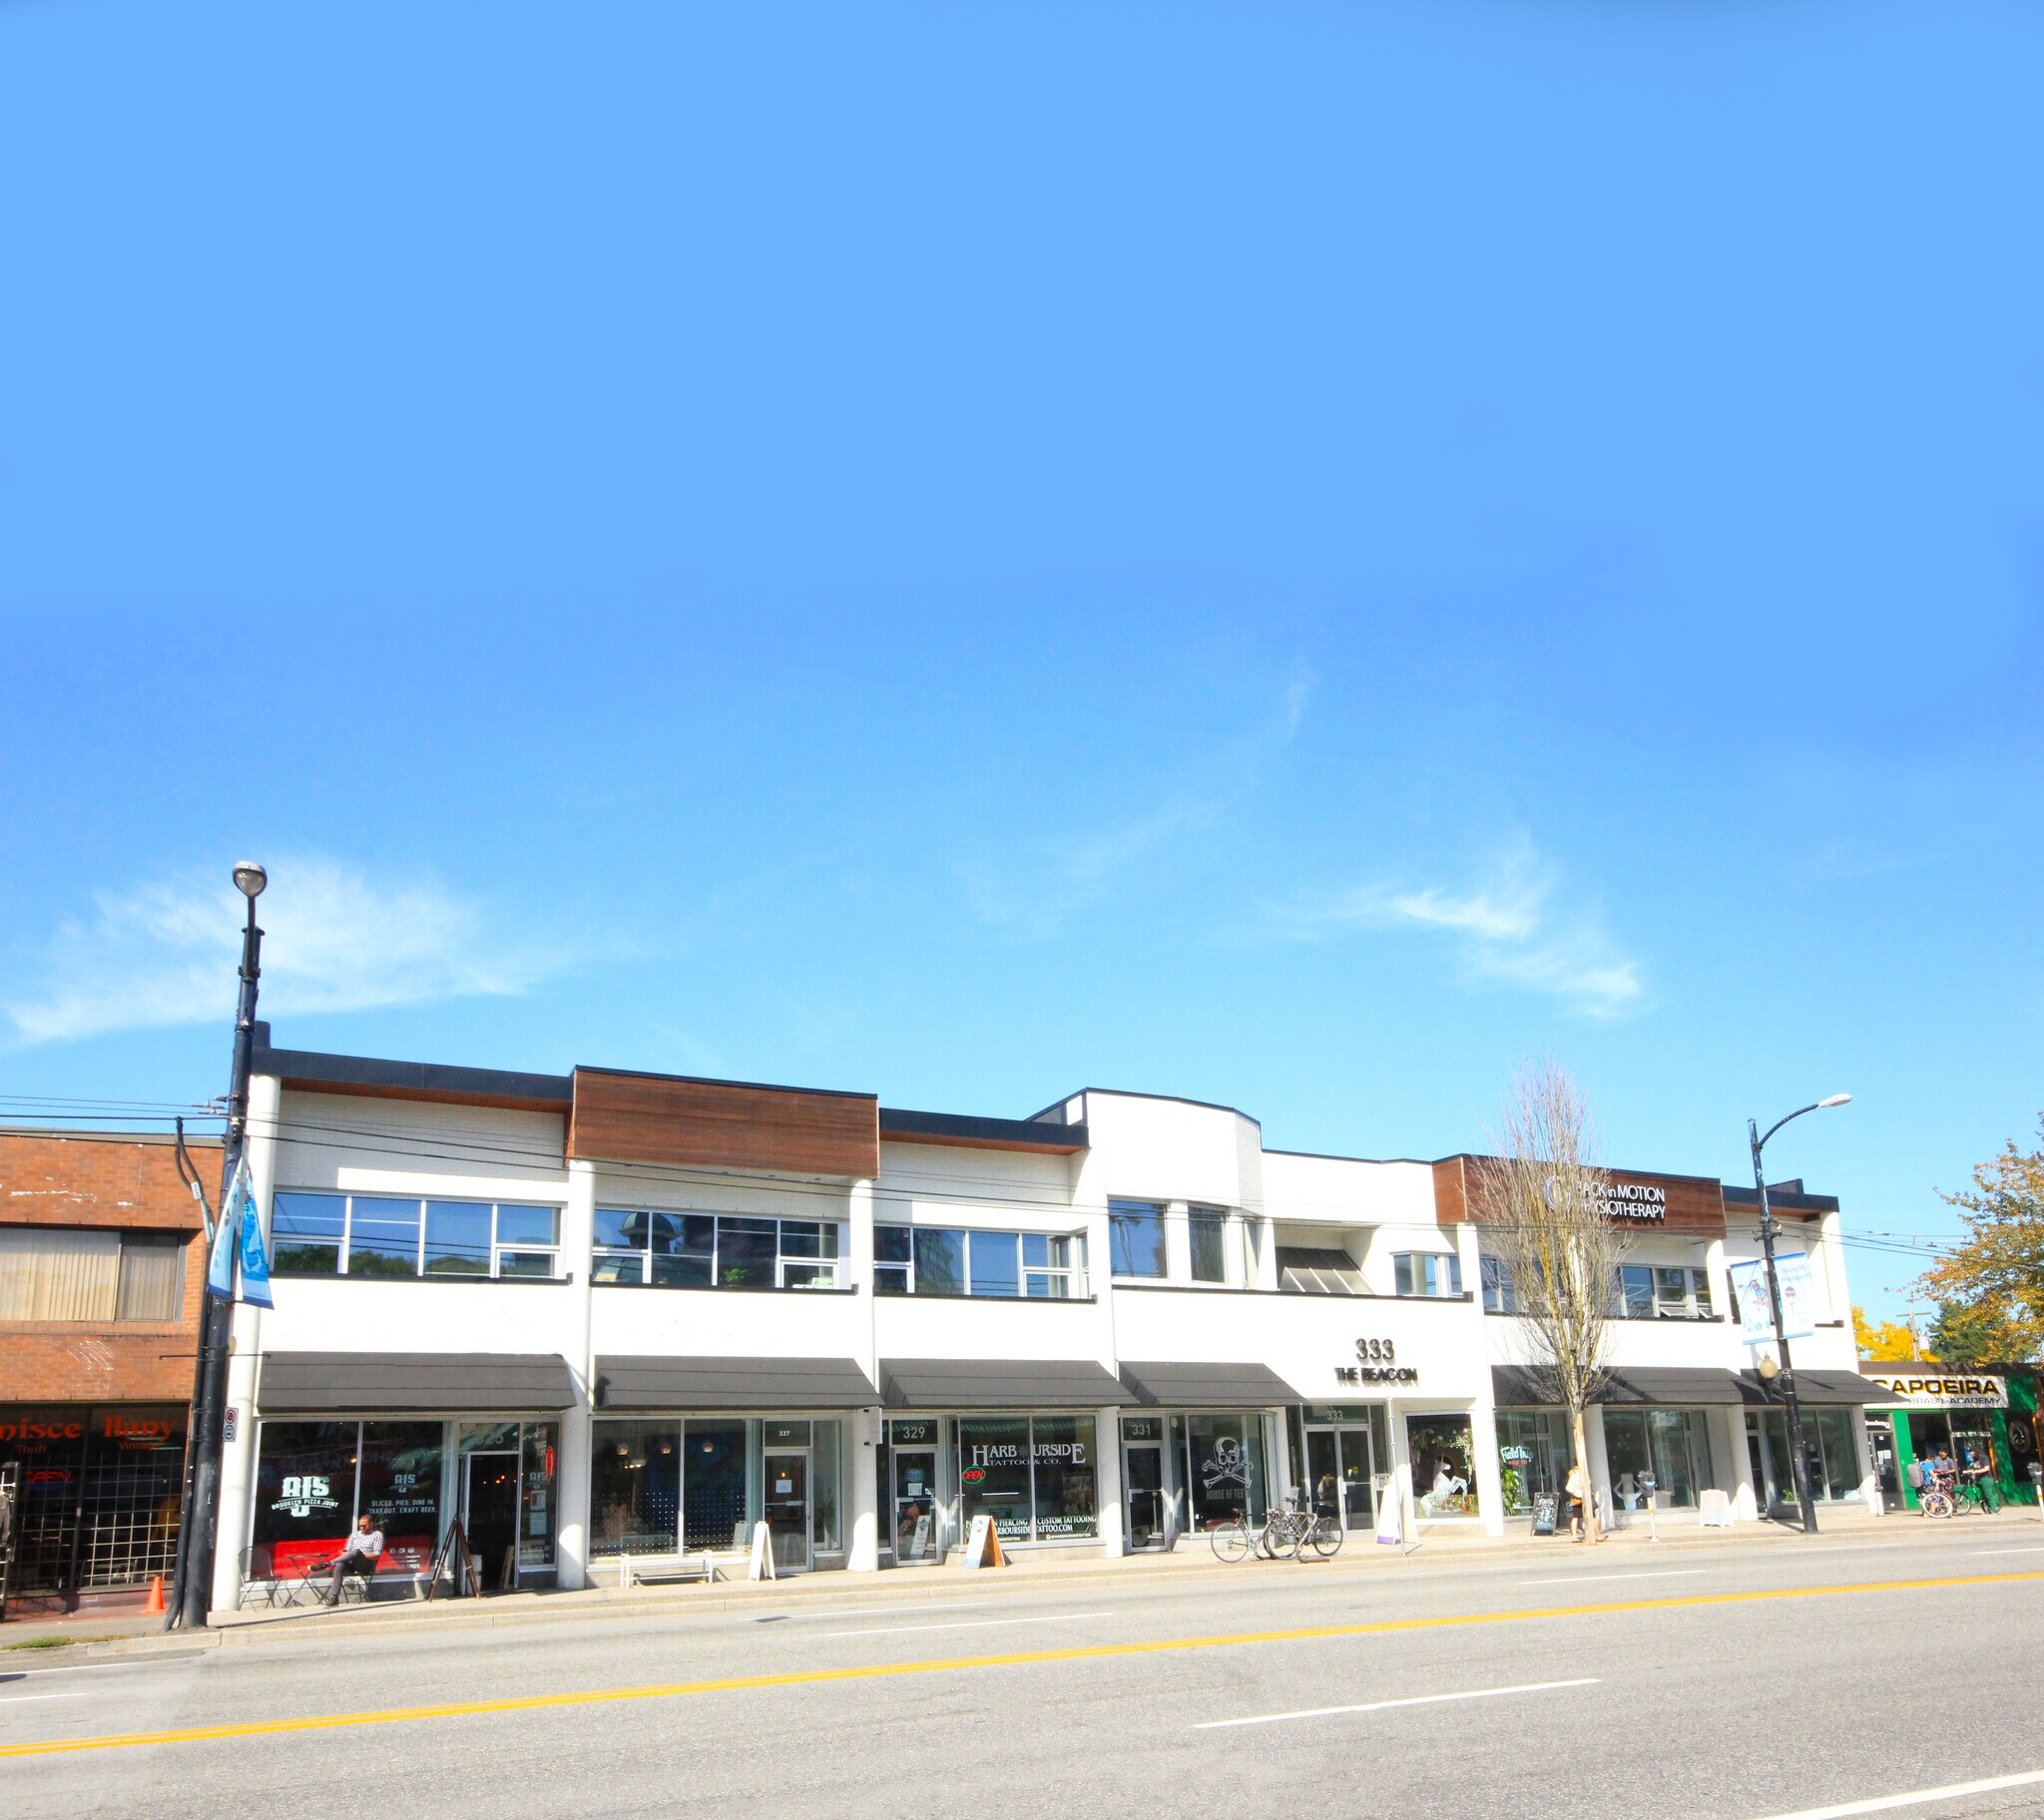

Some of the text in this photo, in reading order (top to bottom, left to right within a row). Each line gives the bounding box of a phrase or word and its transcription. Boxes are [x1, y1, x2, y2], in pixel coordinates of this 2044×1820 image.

[1608, 1184, 1617, 1197] in
[1618, 1184, 1665, 1202] MOTION
[1580, 1197, 1666, 1219] HYSIOTHERAPY
[1355, 1338, 1395, 1359] 333
[1334, 1367, 1417, 1382] THE BEACON
[1326, 1410, 1343, 1421] 333
[903, 1426, 926, 1439] 329
[1132, 1424, 1151, 1436] 331
[16, 1444, 48, 1454] Thrift
[961, 1470, 984, 1480] OPEN
[1206, 1490, 1225, 1500] HOUSE
[1226, 1489, 1233, 1499] OF
[999, 1518, 1028, 1527] PIERCING
[1037, 1516, 1063, 1526] CUSTOM
[1064, 1515, 1097, 1524] TATTOOING
